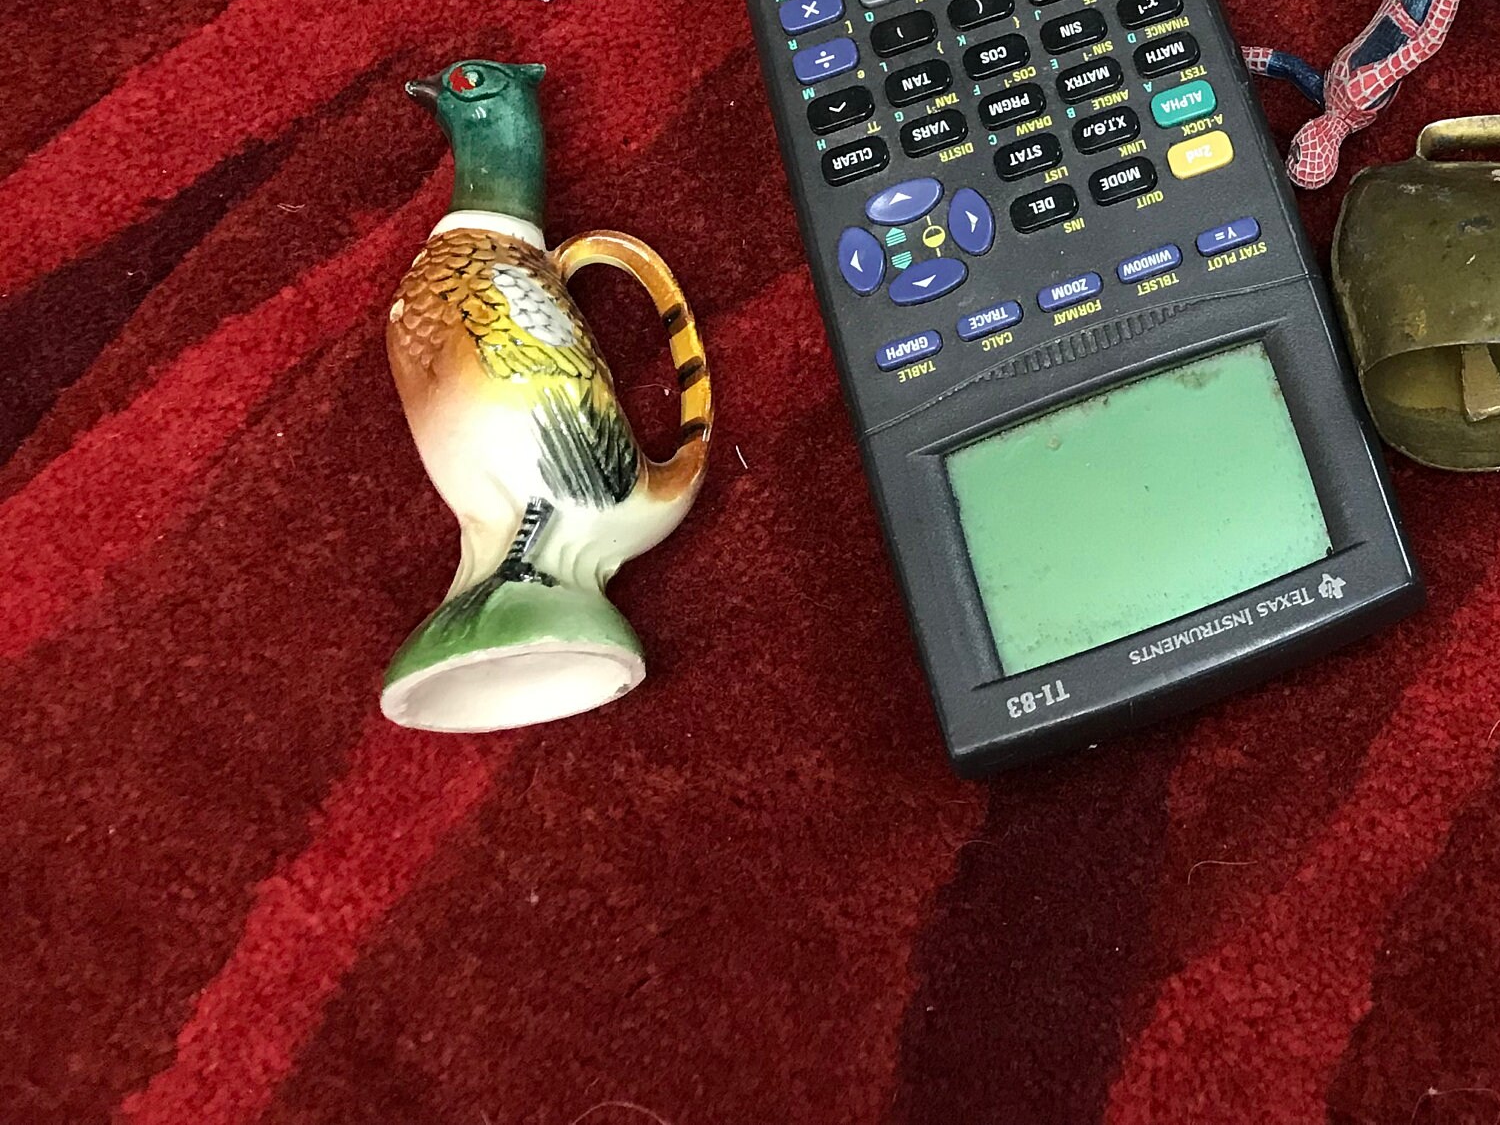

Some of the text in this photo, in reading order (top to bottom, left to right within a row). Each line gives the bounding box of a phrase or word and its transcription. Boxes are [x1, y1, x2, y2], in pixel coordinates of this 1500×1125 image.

[1059, 20, 1083, 38] SIN
[1126, 16, 1190, 44] FINANCE D
[787, 39, 797, 51] R
[956, 34, 967, 47] K
[979, 45, 1007, 64] COS
[1145, 40, 1185, 64] MATH
[879, 61, 888, 72] L
[1049, 58, 1059, 70] E
[901, 72, 931, 91] TAN
[1064, 65, 1110, 91] MATRX
[1142, 64, 1207, 93] TEST A
[801, 87, 815, 100] M
[972, 84, 981, 96] F
[988, 93, 1030, 116] PRGM
[1065, 89, 1129, 119] ANGLE B
[1160, 90, 1203, 114] ALPHA
[894, 111, 904, 122] G
[1181, 113, 1224, 136] A-LOCK
[911, 119, 950, 141] VARS
[987, 115, 1052, 145] DRAW C
[816, 138, 827, 151] H
[939, 142, 974, 162] DISTR
[1009, 144, 1043, 166] STAT
[1118, 139, 1147, 157] LINK
[1185, 144, 1212, 163] 2nd
[832, 147, 873, 170] CLEAR
[1043, 166, 1069, 183] LIST
[1099, 166, 1141, 191] MODE
[1028, 196, 1056, 214] DEL
[1136, 190, 1164, 209] QUIT
[1063, 217, 1085, 233] INS
[1123, 249, 1172, 276] WINDOW
[1207, 241, 1267, 272] STAT PLOT
[1051, 278, 1088, 300] ZOOM
[1136, 272, 1179, 295] TBLSET
[968, 306, 1008, 330] TRACE
[1052, 299, 1102, 326] FORMAT
[885, 336, 928, 360] GRAPH
[981, 331, 1013, 351] CALC
[897, 360, 936, 383] TABLE
[1128, 585, 1315, 665] TEXAS INSTRUMENTS
[1006, 679, 1070, 718] TI-83
